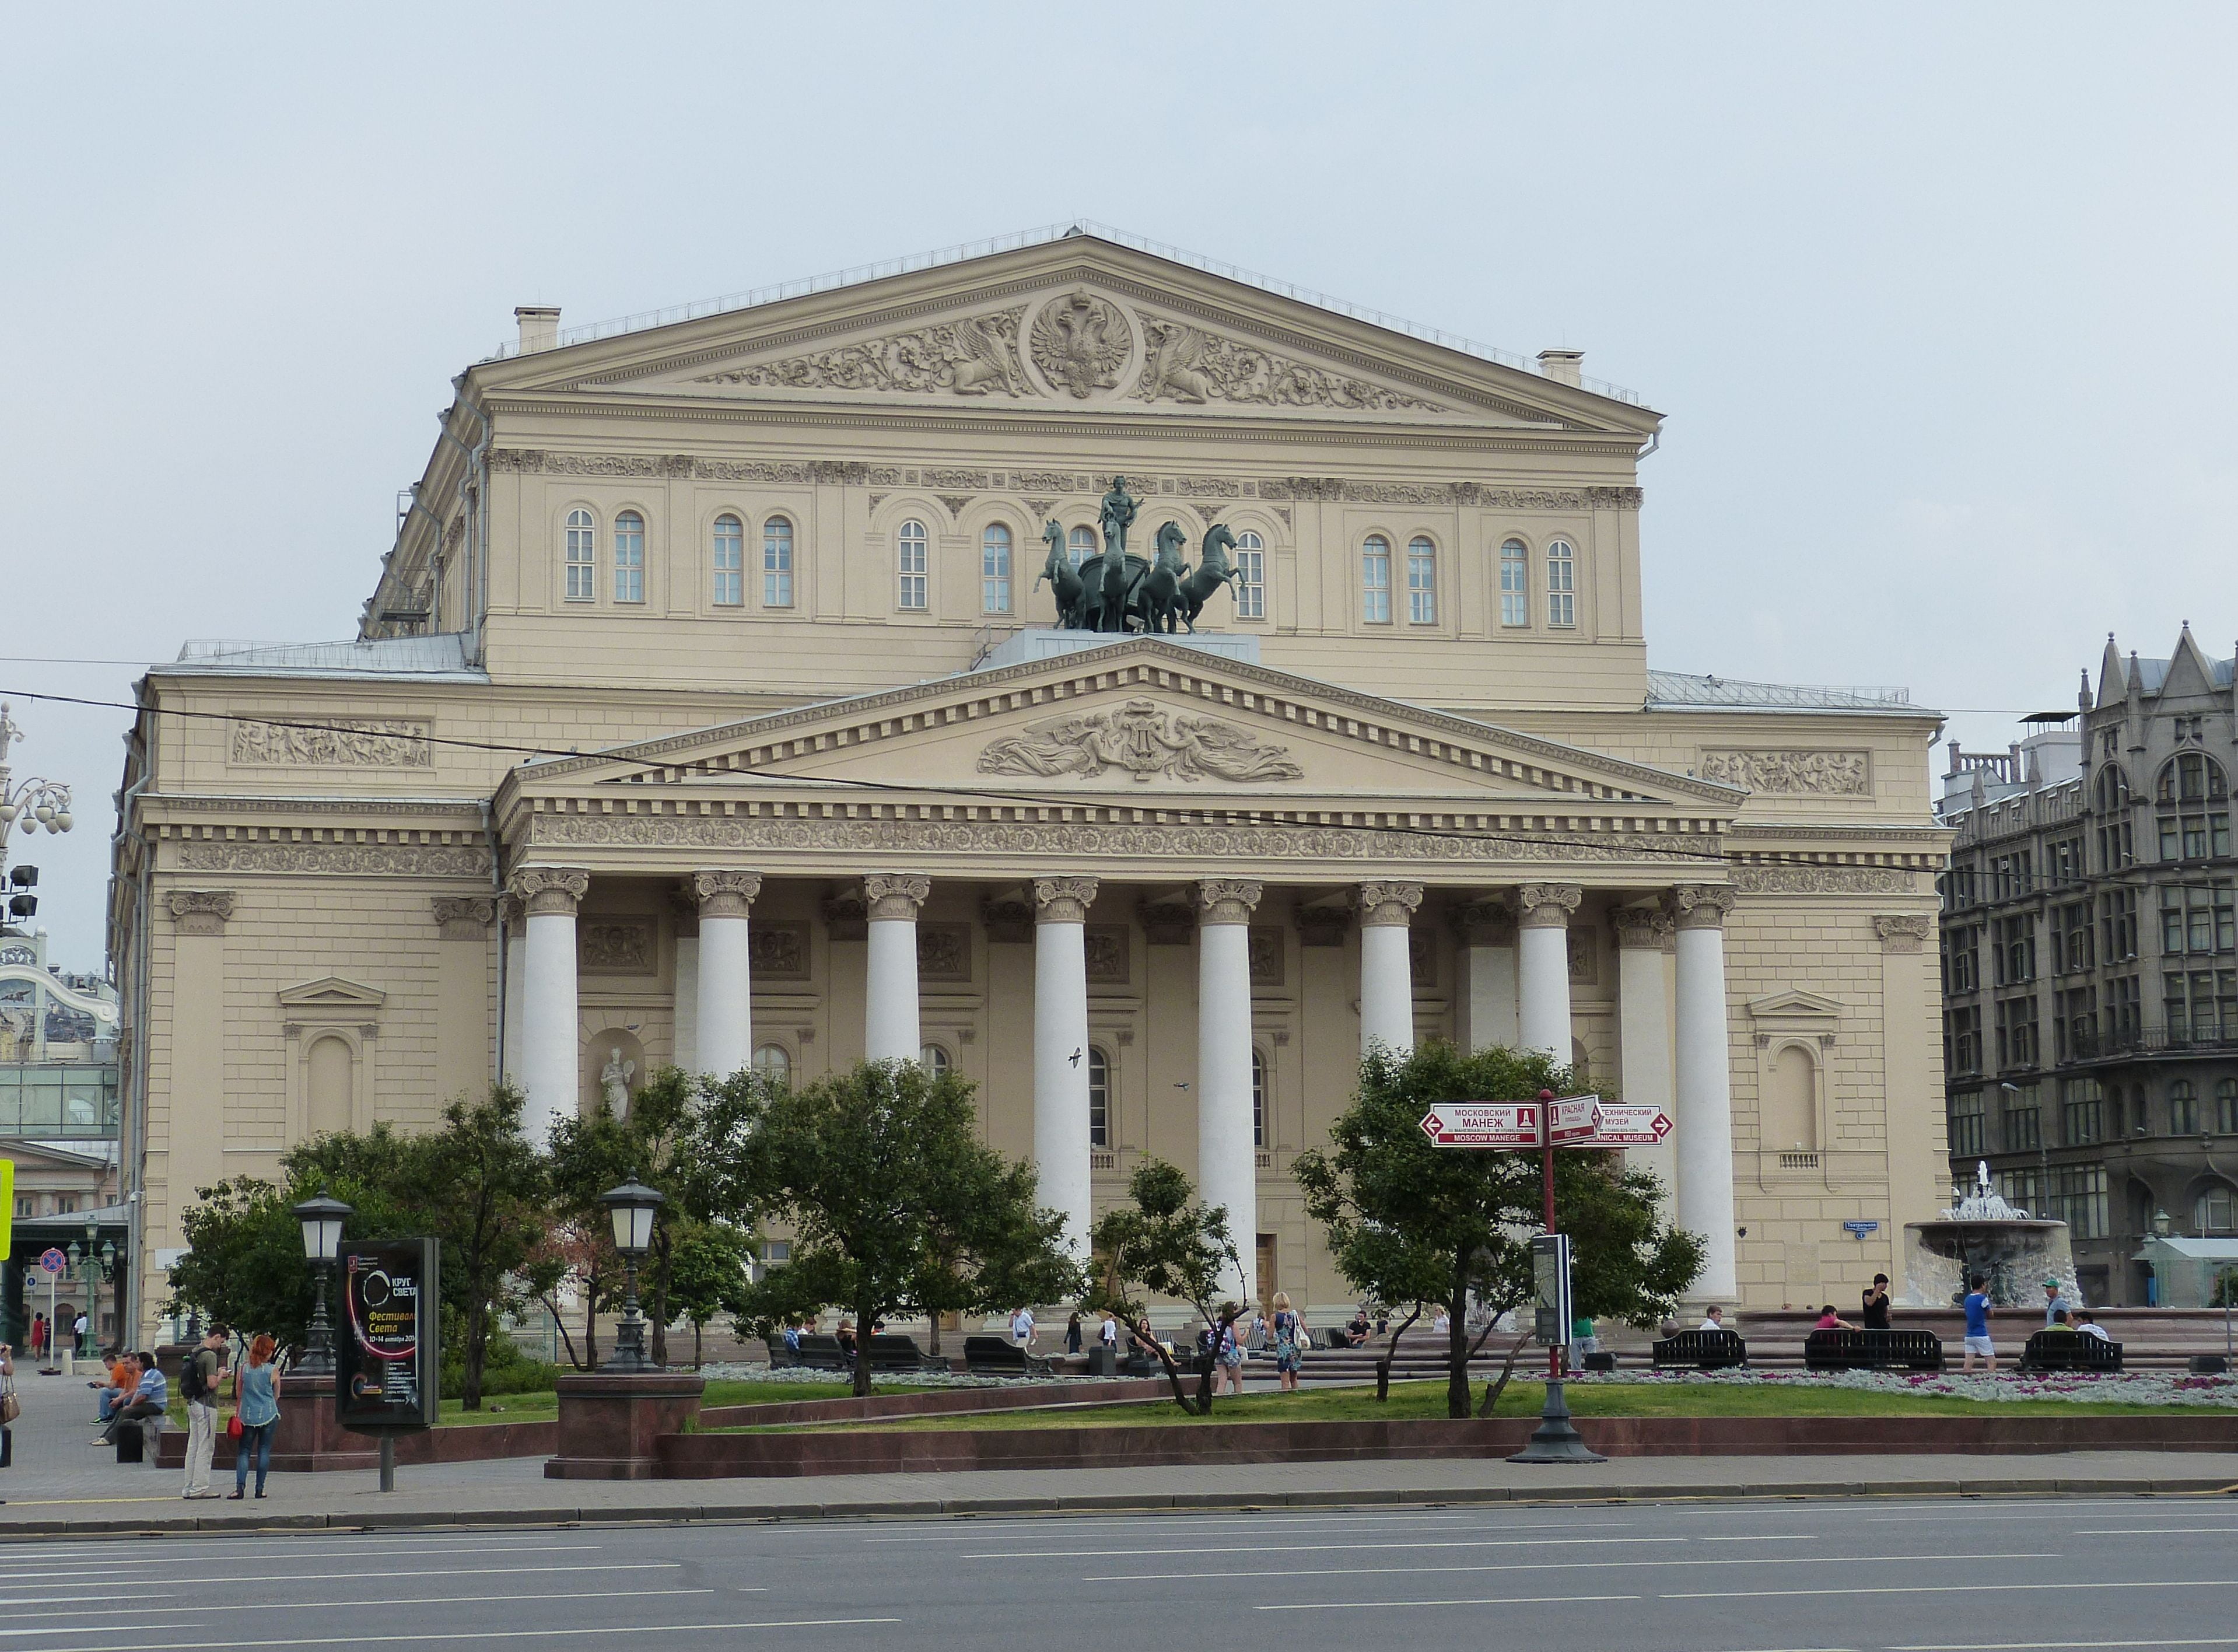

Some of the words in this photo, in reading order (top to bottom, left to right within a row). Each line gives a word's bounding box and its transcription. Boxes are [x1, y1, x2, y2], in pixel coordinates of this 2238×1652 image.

[1561, 1103, 1585, 1115] КРАСНАЯ
[1462, 1118, 1504, 1128] МАНЕЖ
[392, 1278, 411, 1287] КРУГ
[393, 1287, 417, 1297] СВЕТА
[369, 1324, 398, 1333] Света
